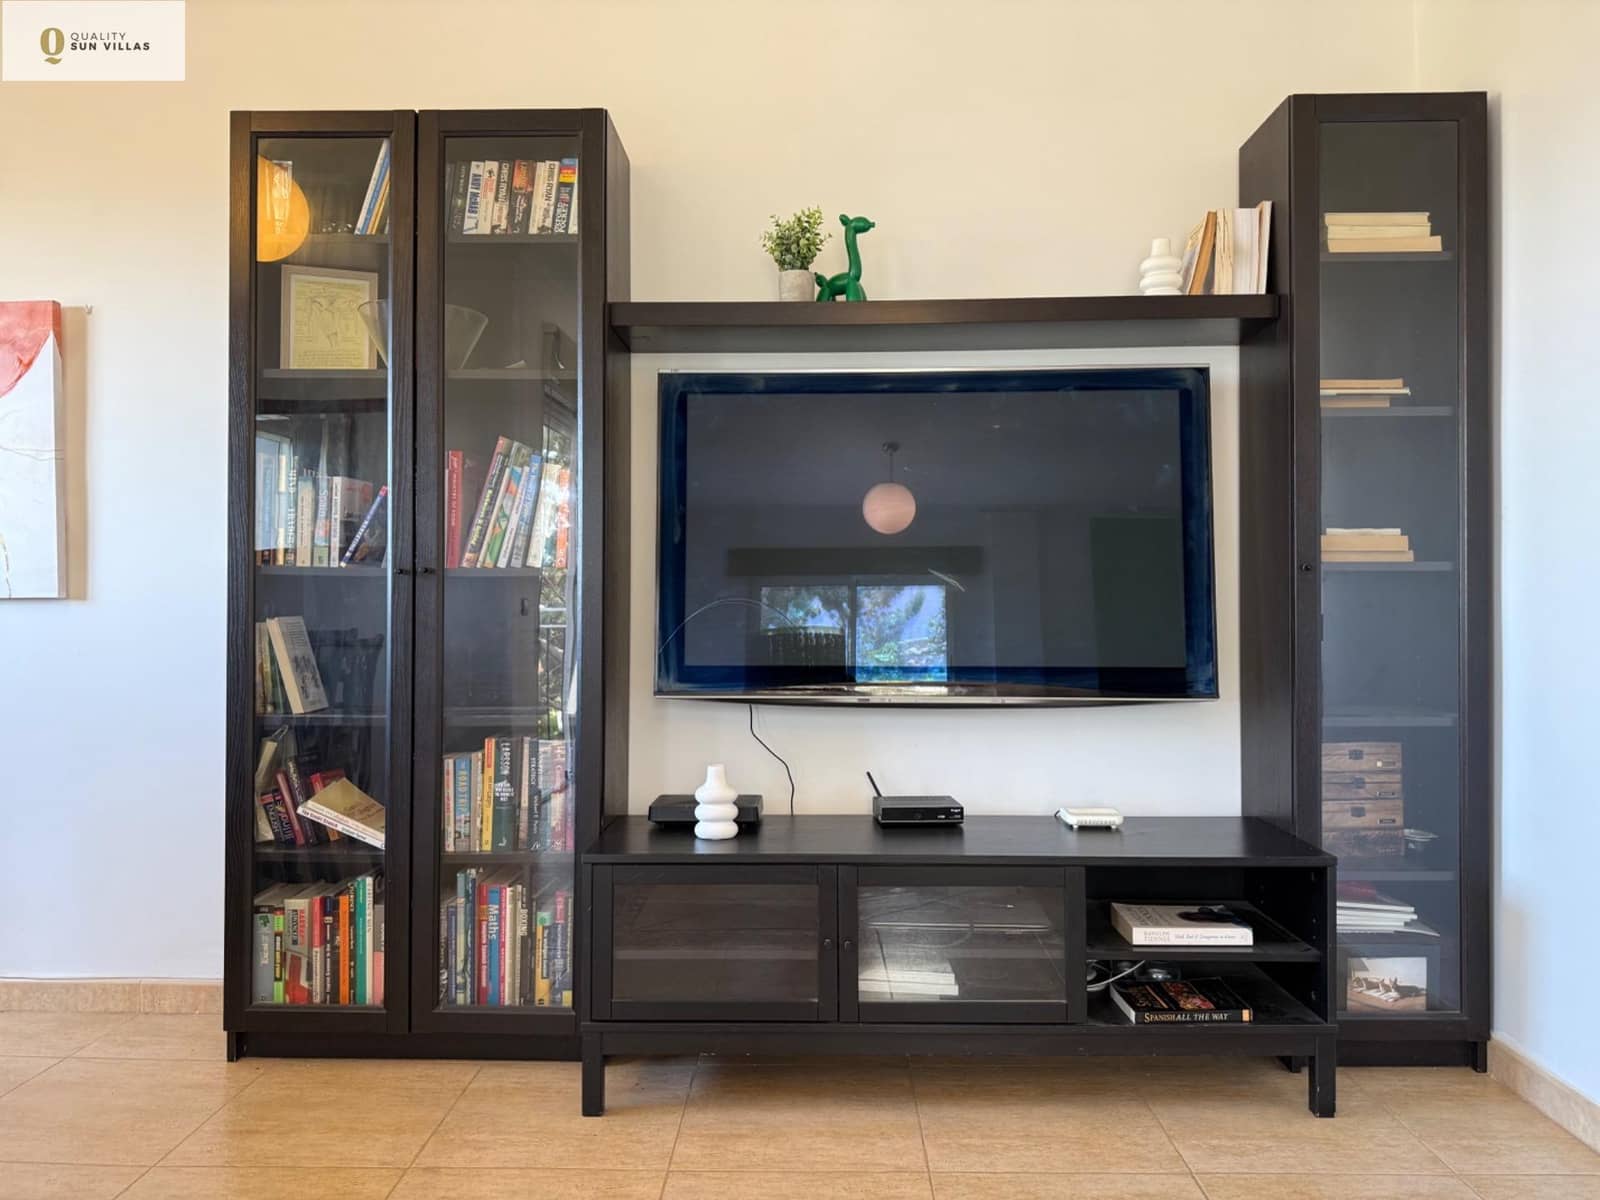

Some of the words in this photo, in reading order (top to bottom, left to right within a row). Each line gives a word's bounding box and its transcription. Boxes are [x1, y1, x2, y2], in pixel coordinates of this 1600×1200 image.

[499, 162, 510, 183] CHRIS
[497, 183, 508, 203] RYAN
[544, 182, 553, 202] RYAN
[318, 488, 329, 518] Spain
[488, 904, 499, 940] Maths
[519, 908, 528, 937] BOXING
[1175, 1013, 1192, 1022] ALL
[1193, 1013, 1210, 1021] THE
[1211, 1013, 1229, 1021] WAY
